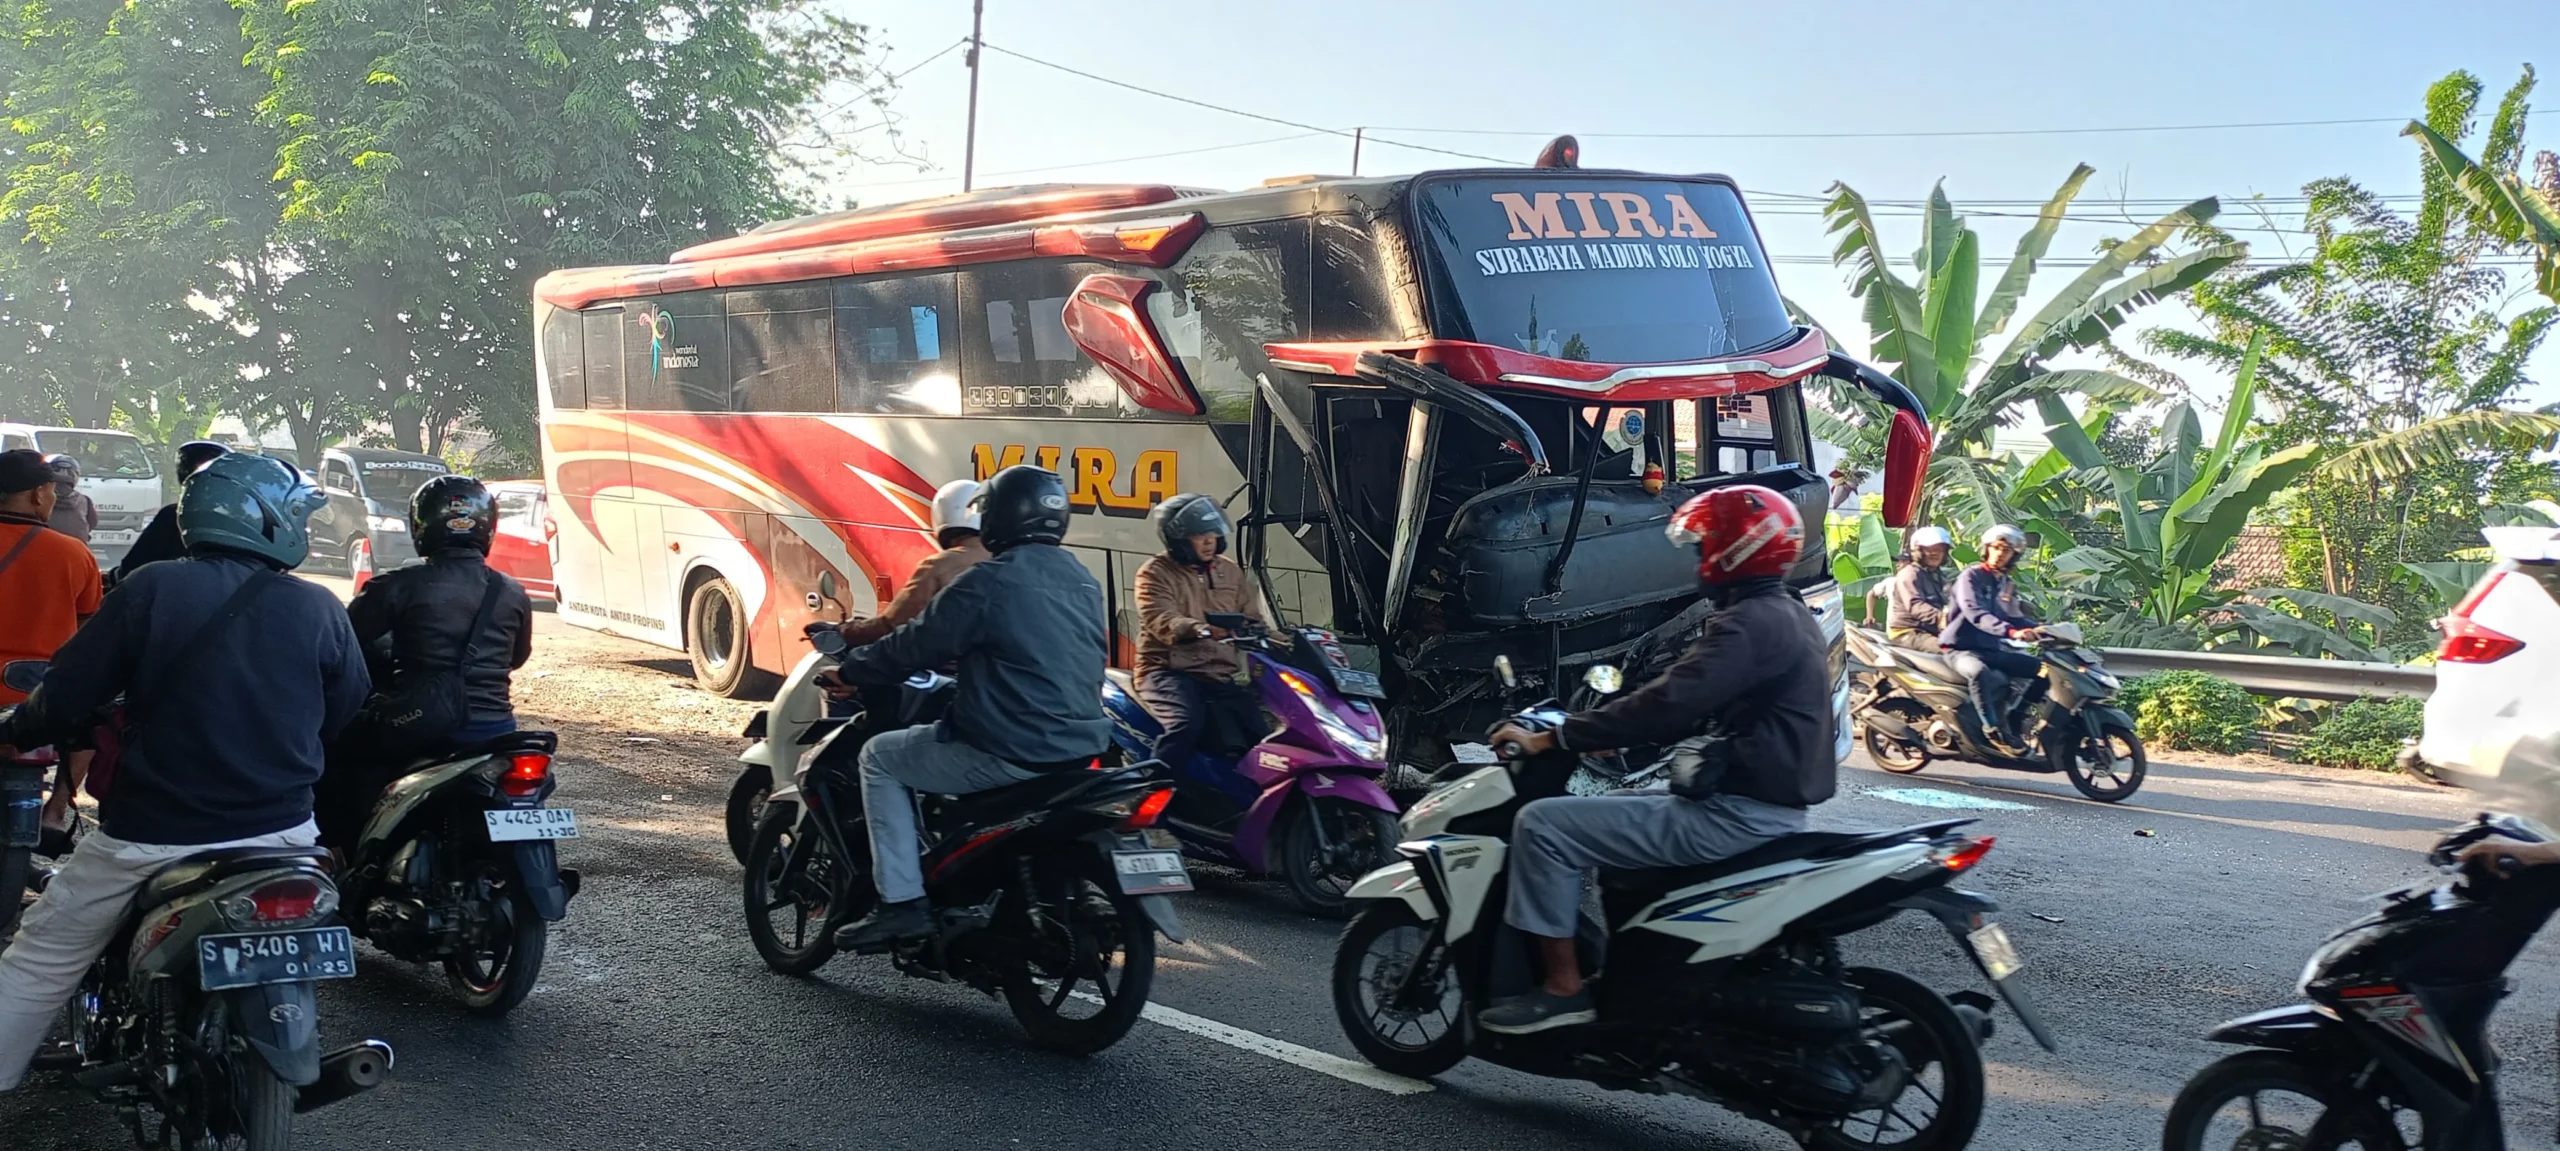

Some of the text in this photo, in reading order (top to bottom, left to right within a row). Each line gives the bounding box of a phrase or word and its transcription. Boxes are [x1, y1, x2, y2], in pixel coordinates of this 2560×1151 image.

[1491, 192, 1718, 241] MIRA
[1475, 243, 1754, 277] SURABAYA MADIUN SOLO YOGYA
[675, 344, 698, 354] wonderful
[95, 503, 124, 511] ISUZU
[569, 601, 665, 631] ANTAR KOTA ANTAR PROPINSI
[487, 811, 498, 826] S
[504, 810, 542, 825] 4425
[203, 931, 346, 961] S 5406 WI
